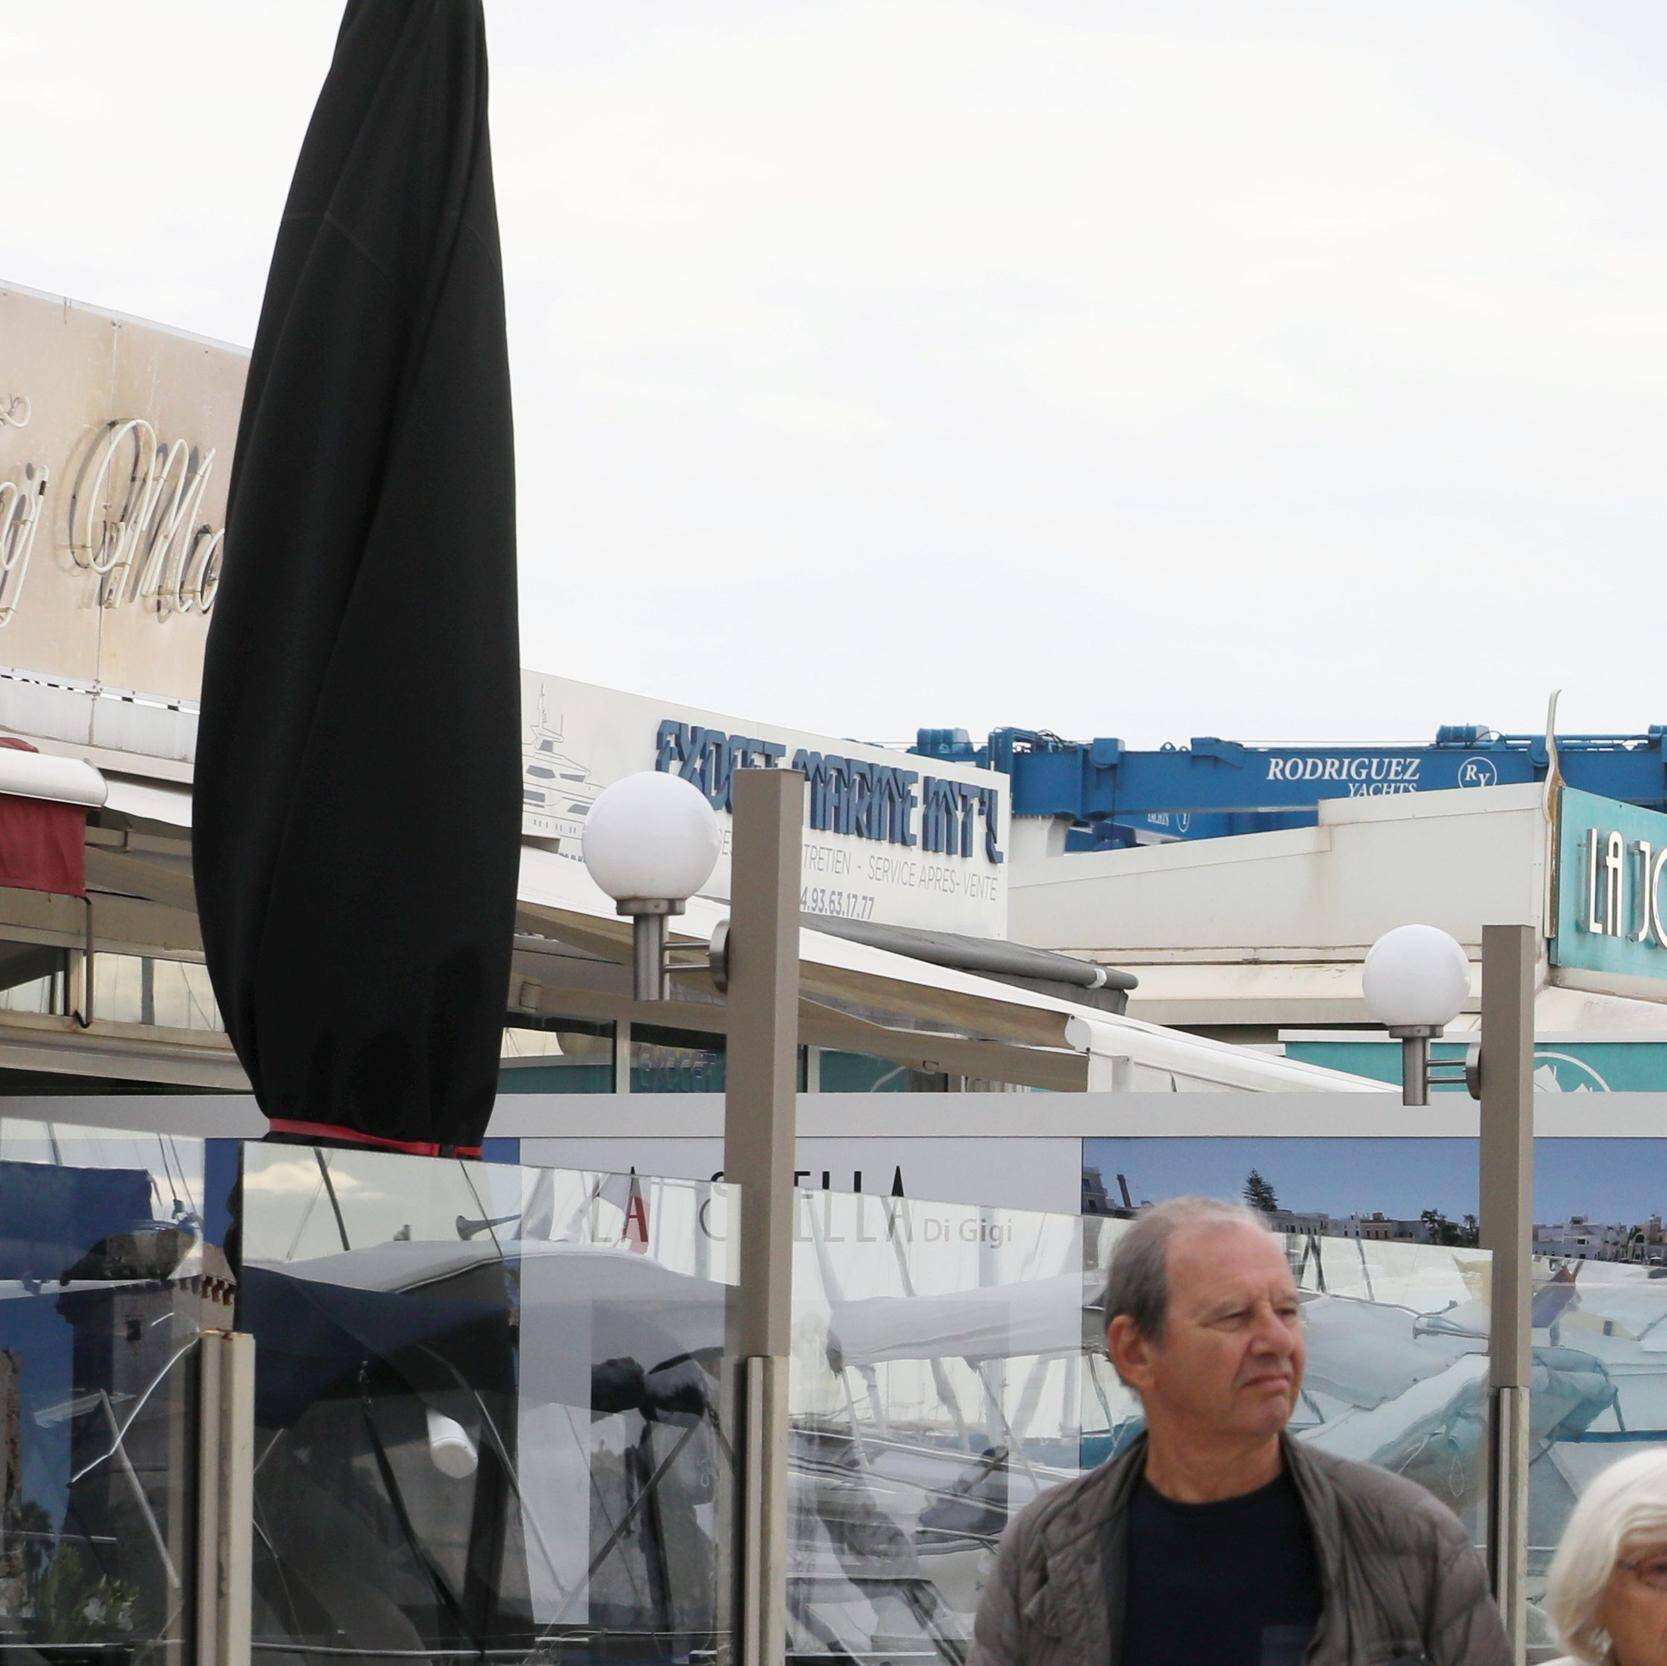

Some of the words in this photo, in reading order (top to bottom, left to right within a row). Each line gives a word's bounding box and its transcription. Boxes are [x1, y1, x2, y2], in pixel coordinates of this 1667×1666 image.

[1266, 757, 1421, 780] RODRIGUEZ
[867, 855, 916, 888] SERVICE
[964, 875, 998, 902] VENTE
[1588, 827, 1624, 938] LA
[923, 1217, 951, 1243] Di
[958, 1217, 1014, 1249] Gigi
